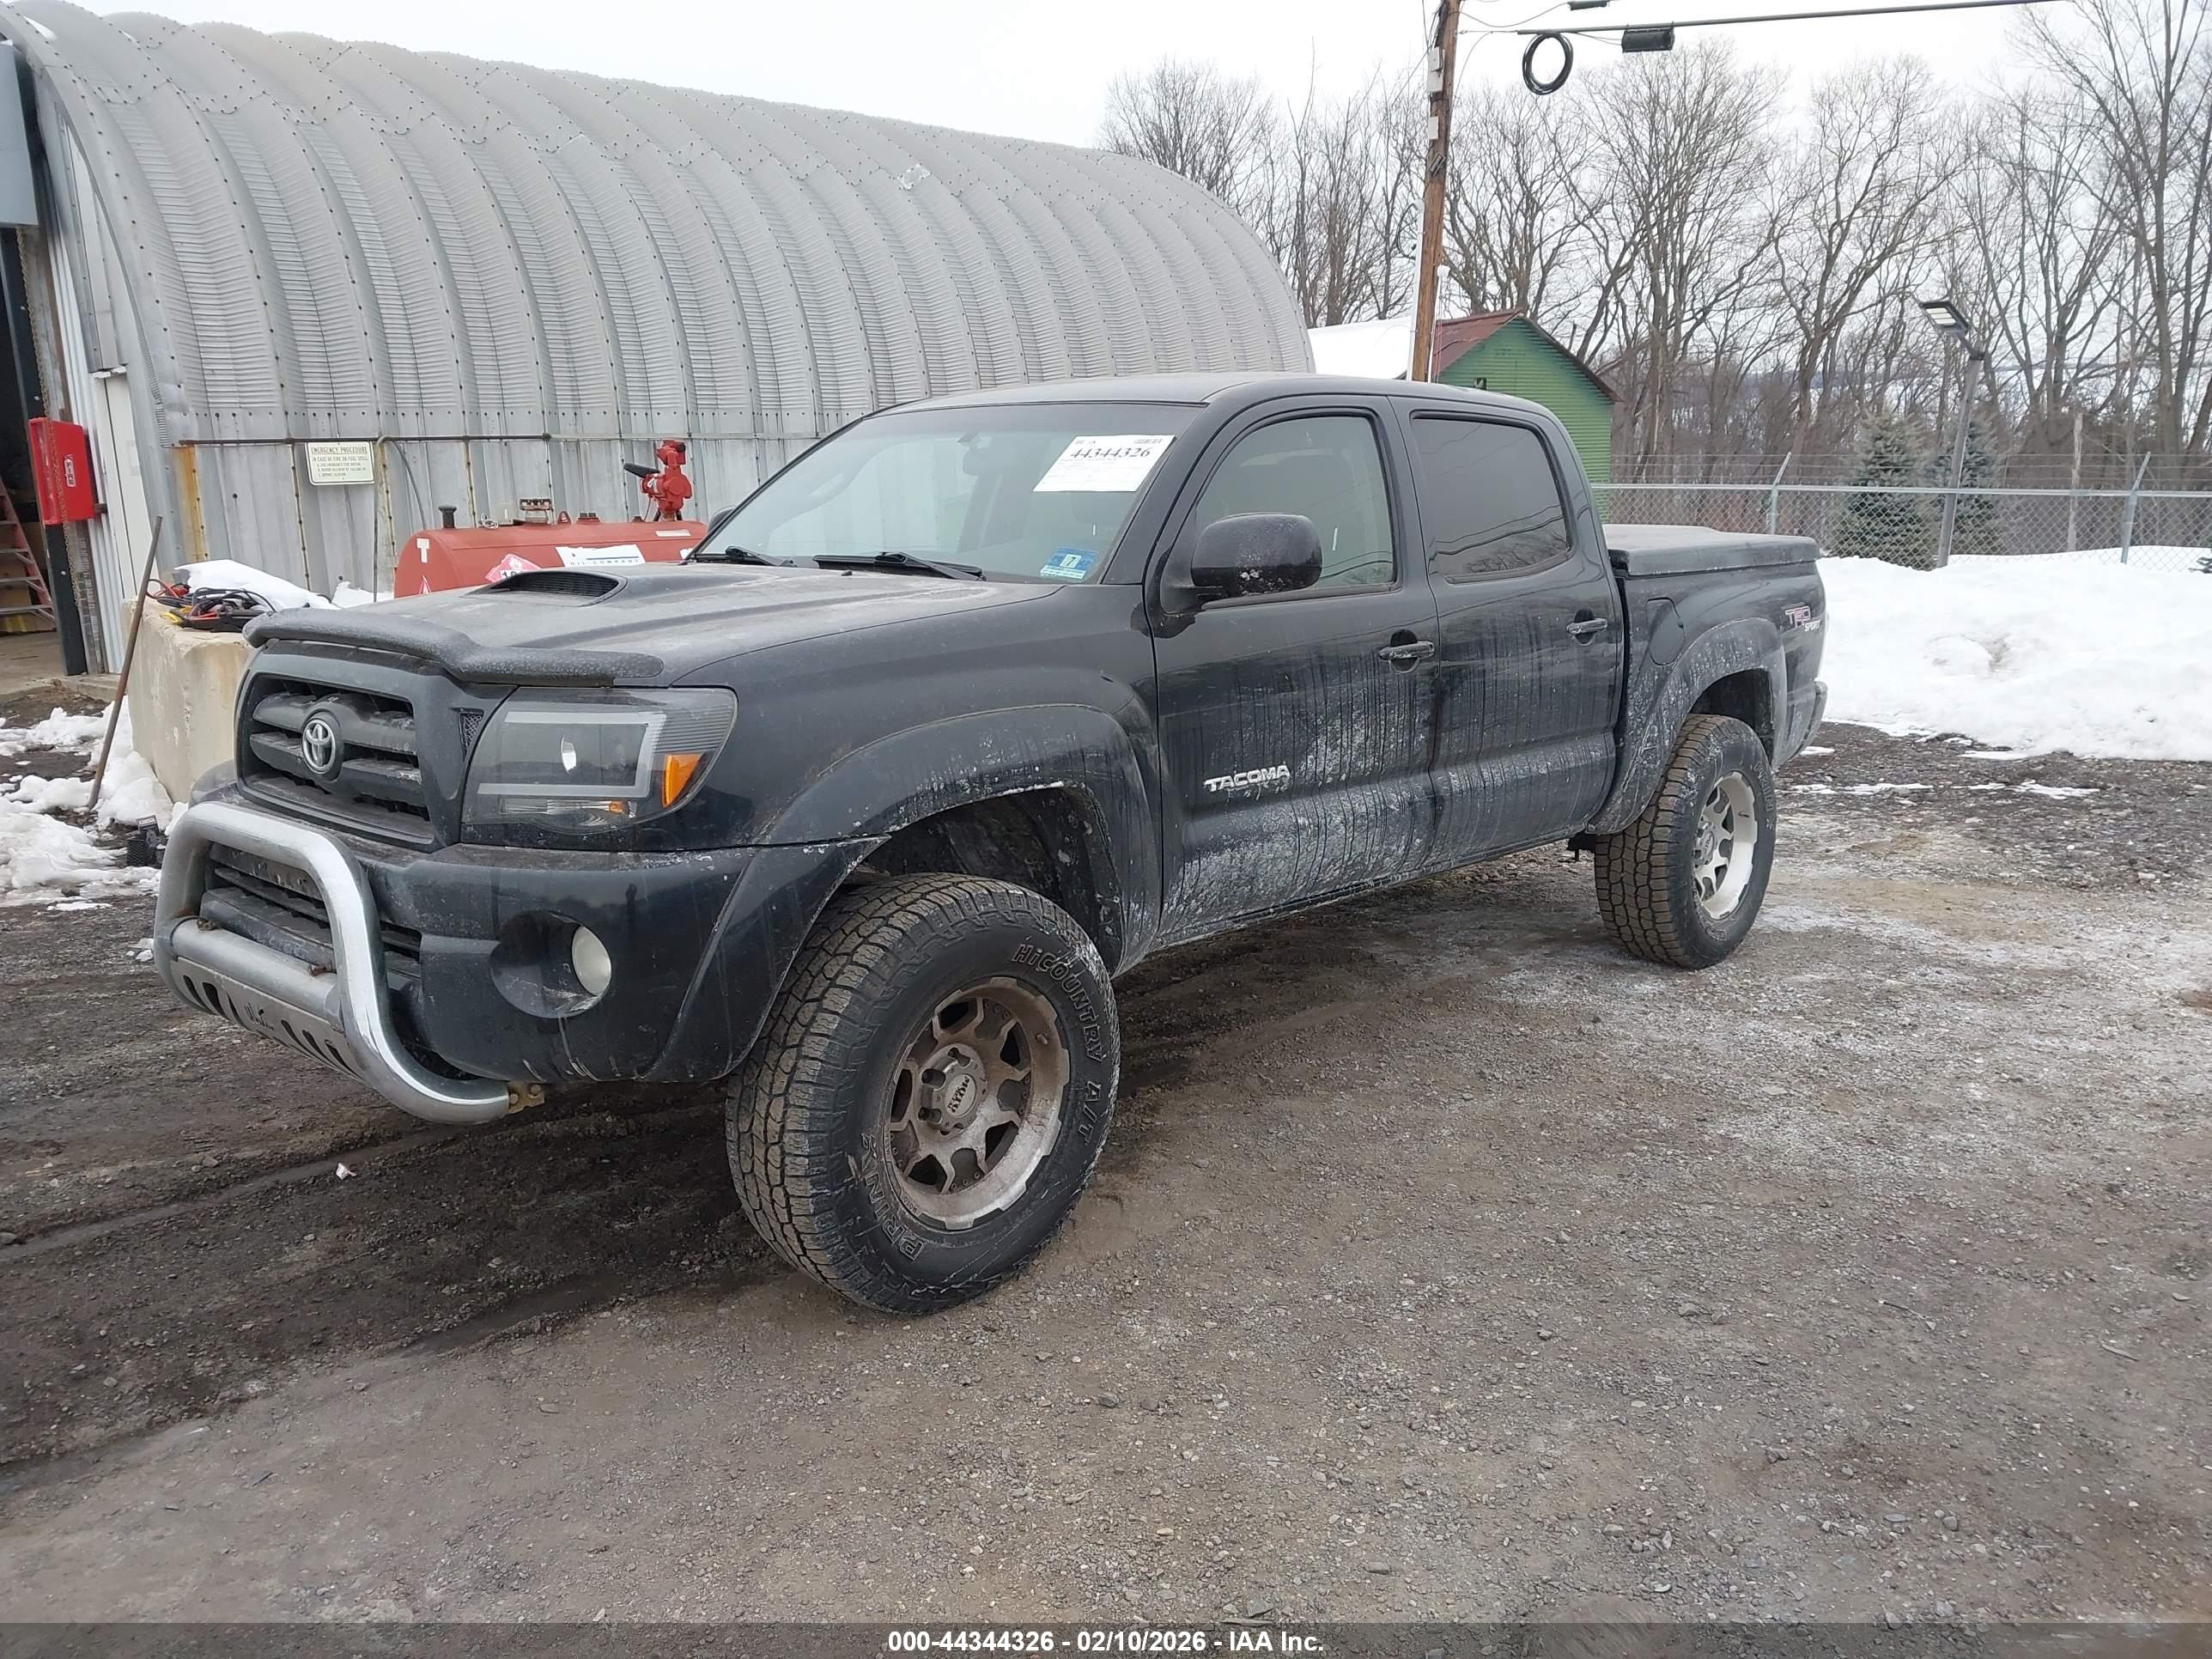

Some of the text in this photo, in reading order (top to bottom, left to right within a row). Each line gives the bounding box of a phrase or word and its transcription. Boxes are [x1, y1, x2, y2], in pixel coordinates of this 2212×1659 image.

[1071, 447, 1153, 459] 44344326
[1785, 605, 1811, 629] TRD
[1804, 619, 1822, 633] SPORT
[1203, 764, 1291, 792] TACOMA
[1079, 1080, 1102, 1147] A/T
